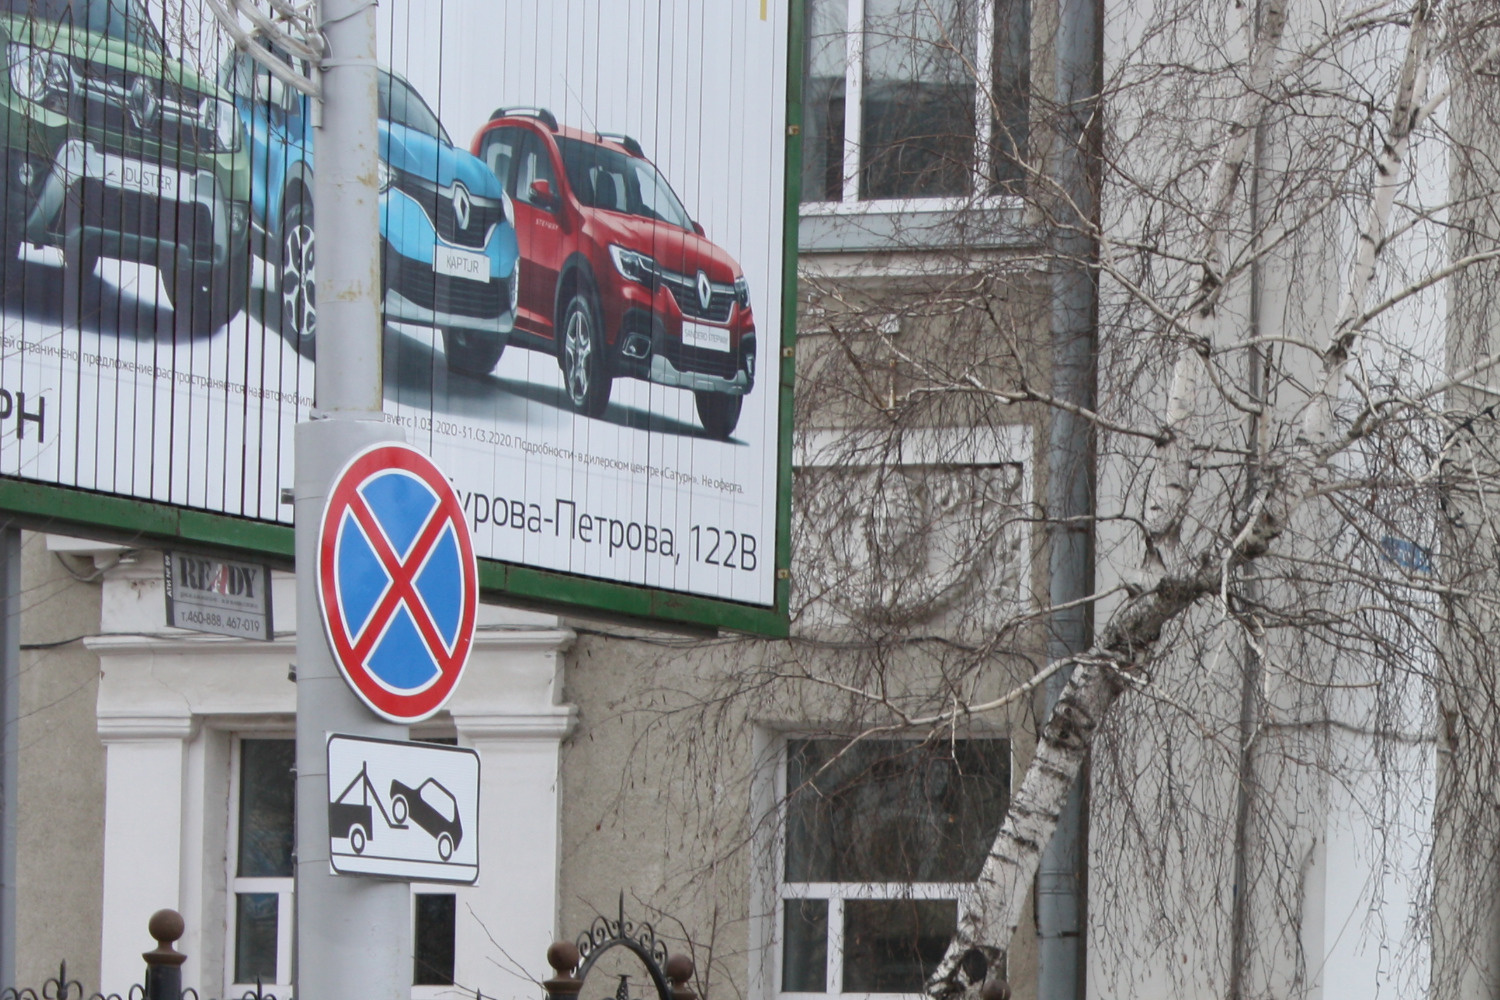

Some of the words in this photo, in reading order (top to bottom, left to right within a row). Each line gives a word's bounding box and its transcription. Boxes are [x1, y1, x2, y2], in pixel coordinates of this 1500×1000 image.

[82, 352, 153, 375] предложение
[514, 436, 573, 460] Подробности
[583, 453, 630, 472] дилерском
[631, 461, 659, 478] центре
[701, 474, 713, 488] Не
[449, 478, 680, 566] урова-Петрова,
